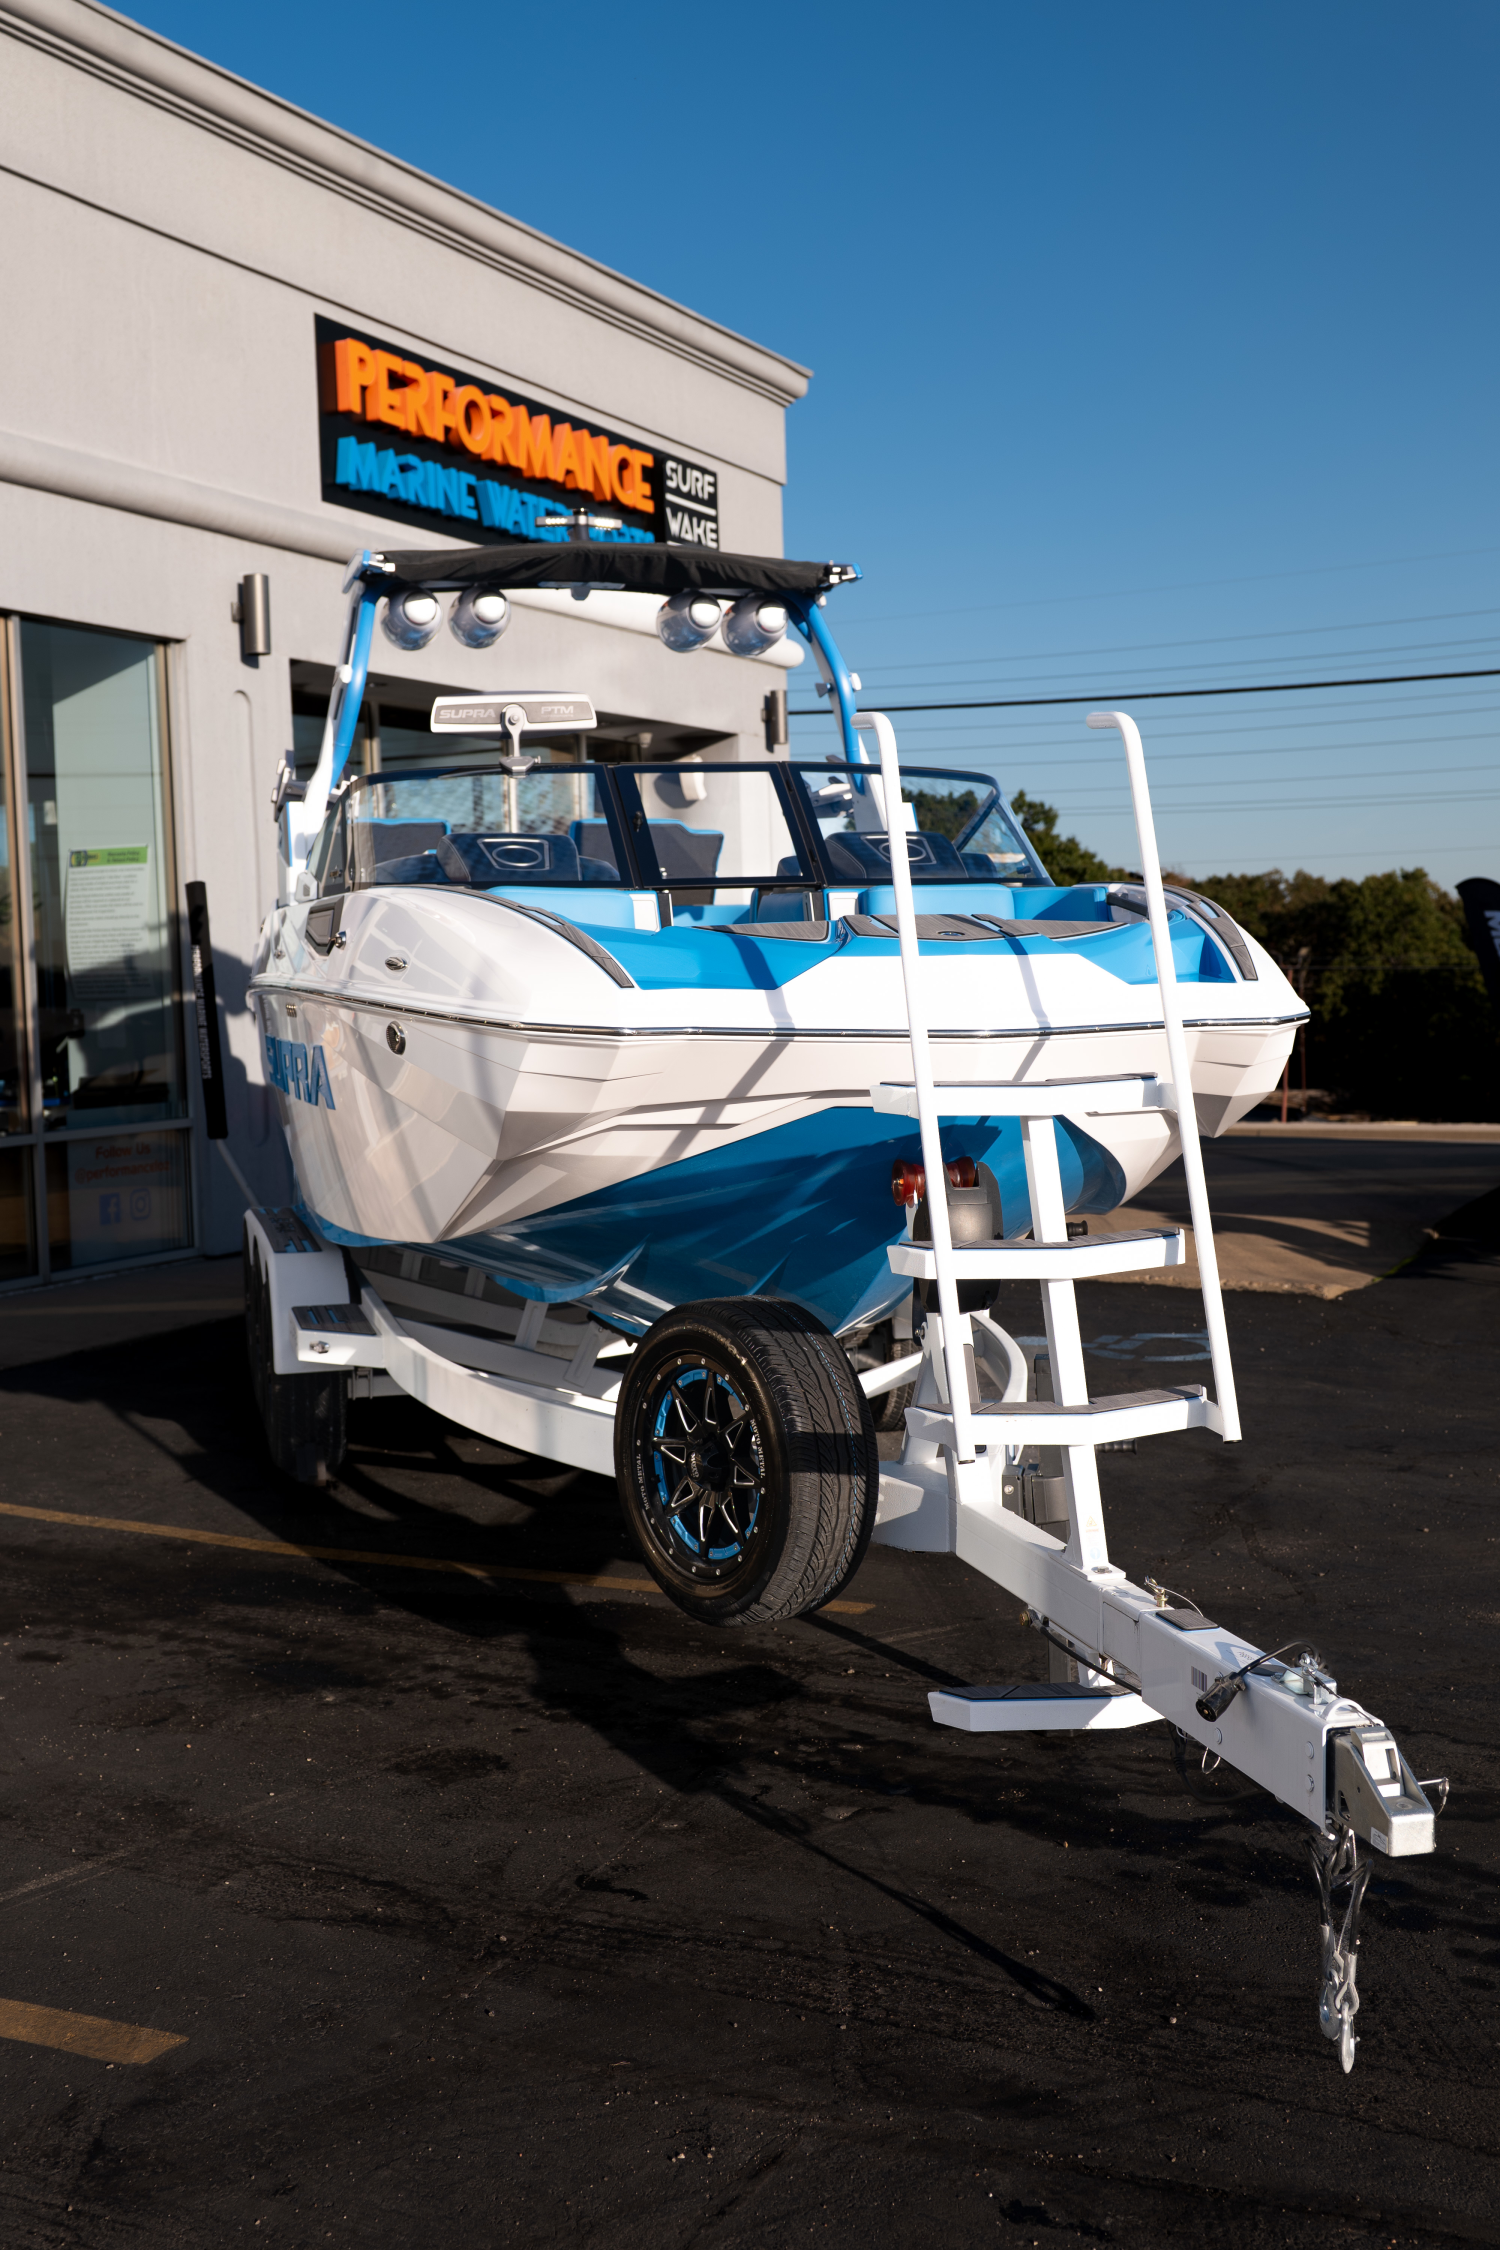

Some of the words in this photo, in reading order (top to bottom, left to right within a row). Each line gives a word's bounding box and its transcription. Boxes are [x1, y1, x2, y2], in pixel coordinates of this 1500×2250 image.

[335, 338, 655, 514] PERFORMANCE
[336, 436, 479, 521] MARINE
[665, 460, 716, 501] SURF
[665, 507, 718, 549] WAKE
[439, 708, 496, 719] SUPRA
[541, 705, 574, 714] PTM
[95, 1145, 133, 1160] Follow
[135, 1141, 151, 1156] Us
[750, 1418, 761, 1446] MOTO
[757, 1446, 766, 1479] METAL
